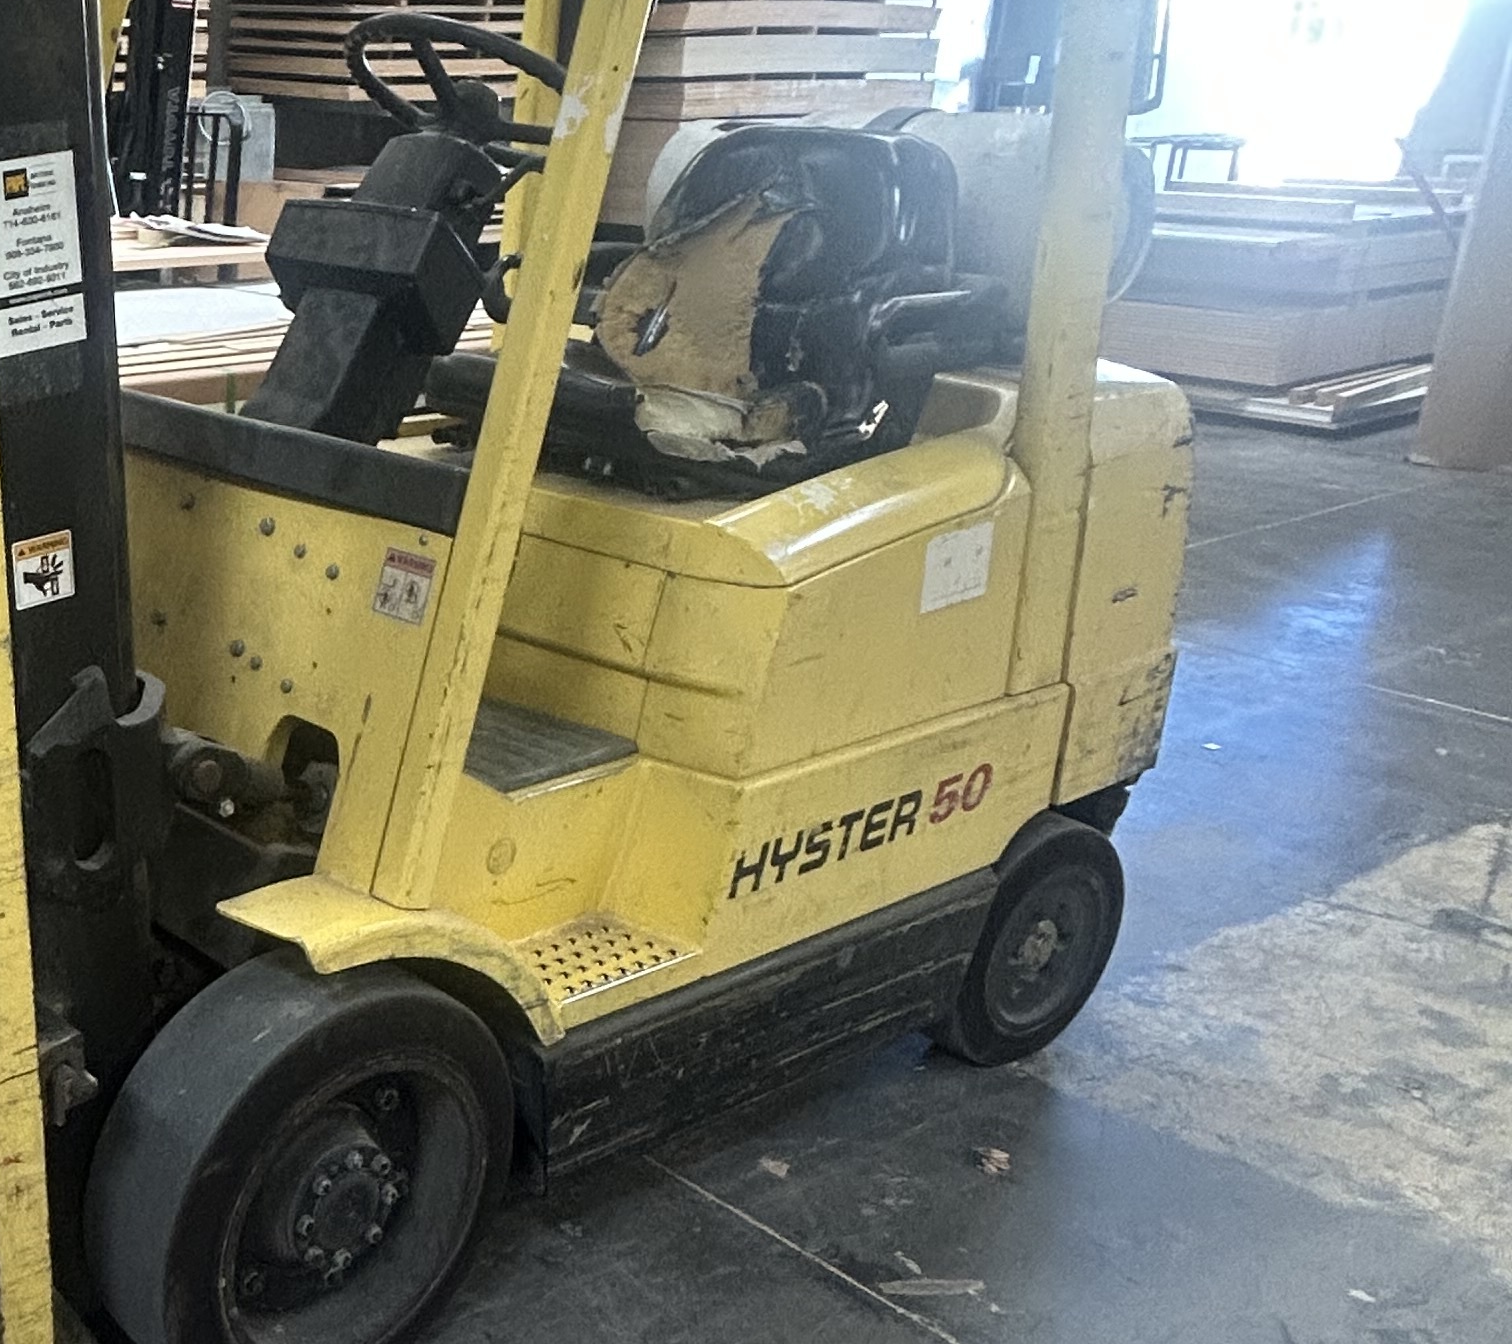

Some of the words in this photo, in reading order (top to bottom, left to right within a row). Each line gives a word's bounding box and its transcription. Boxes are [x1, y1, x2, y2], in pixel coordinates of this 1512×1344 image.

[161, 86, 181, 173] TOYOTA
[11, 323, 40, 337] Rental
[49, 318, 73, 329] Parts
[41, 306, 74, 319] Service
[727, 789, 923, 900] HYSTER
[928, 762, 994, 825] 50
